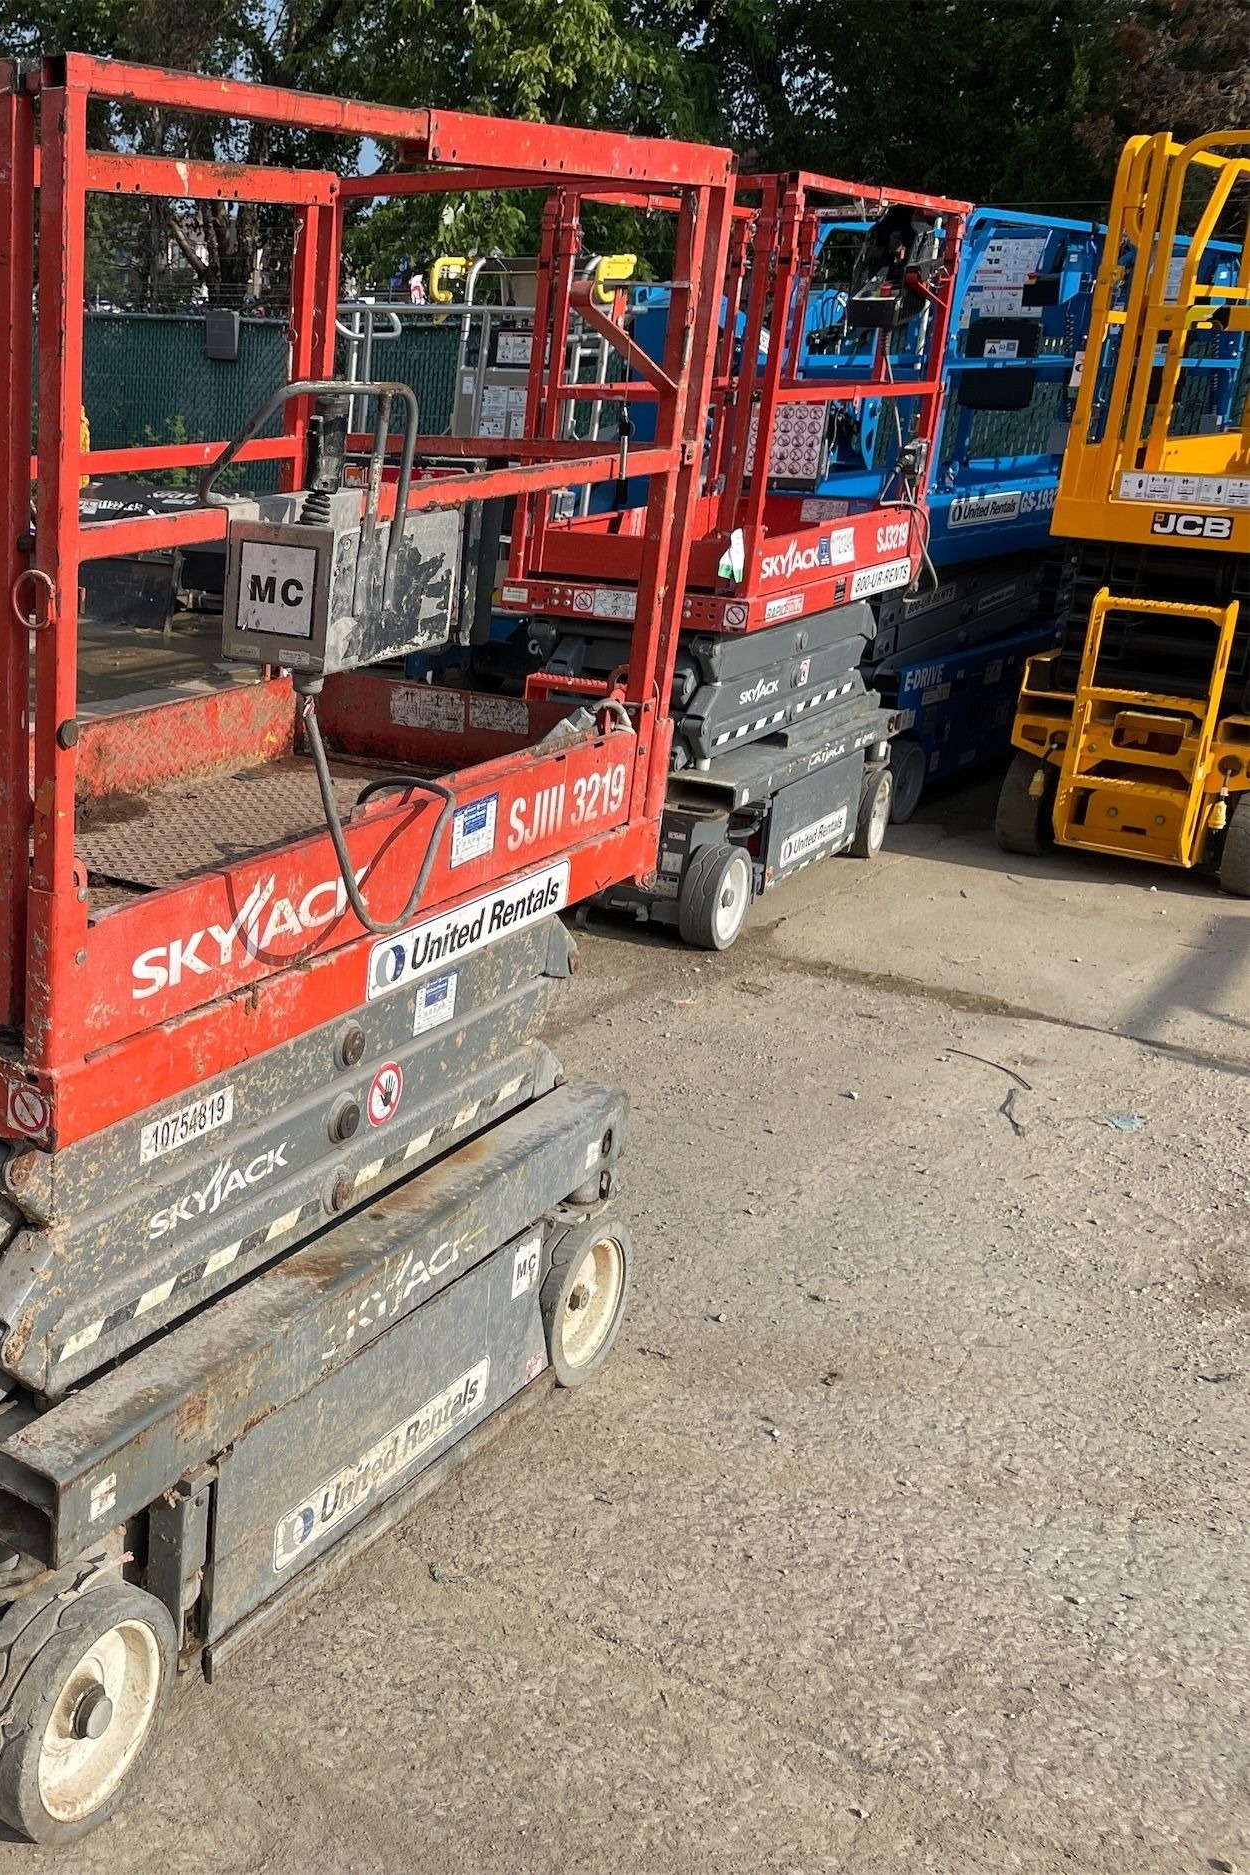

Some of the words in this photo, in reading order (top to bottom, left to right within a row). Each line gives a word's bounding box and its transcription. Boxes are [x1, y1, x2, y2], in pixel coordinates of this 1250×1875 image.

[963, 502, 989, 520] United
[990, 497, 1016, 515] Rentals
[1153, 514, 1231, 538] JCB
[876, 521, 910, 553] SJ3219
[760, 539, 819, 579] SKYJACK
[249, 574, 304, 607] MC
[855, 565, 908, 593] 800-UR-RENTS
[739, 679, 779, 705] SKYJACK
[904, 664, 945, 692] E-DRIVE
[507, 783, 566, 851] SJIII
[570, 763, 626, 827] 3219
[793, 828, 817, 853] United
[817, 813, 843, 840] Rentals
[132, 864, 370, 999] SKYJACK
[411, 908, 485, 970] United
[488, 876, 560, 934] Rentals
[152, 1095, 225, 1152] 10754819
[150, 1141, 288, 1240] SKYJACK
[516, 1253, 537, 1281] MC
[321, 1435, 398, 1523] United
[403, 1378, 480, 1451] Rentals
